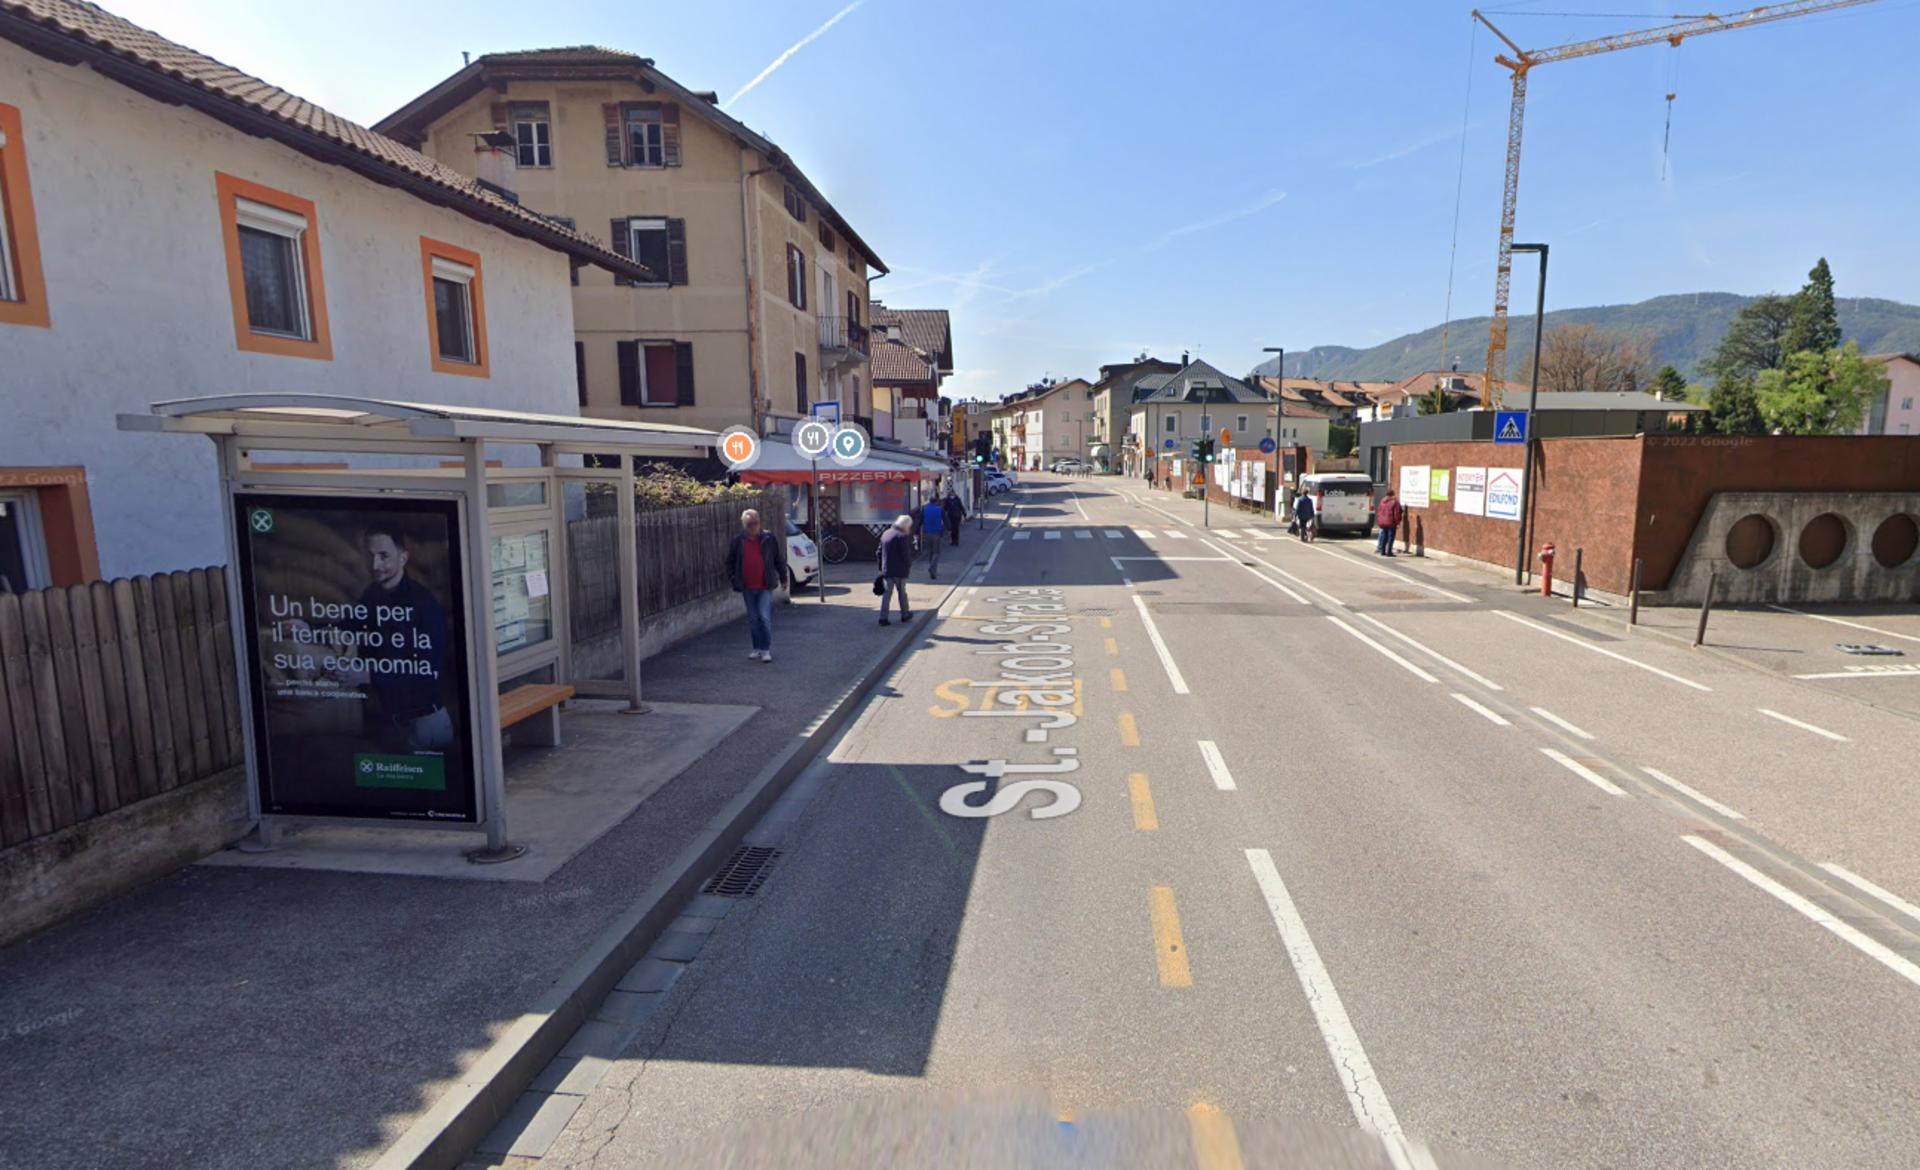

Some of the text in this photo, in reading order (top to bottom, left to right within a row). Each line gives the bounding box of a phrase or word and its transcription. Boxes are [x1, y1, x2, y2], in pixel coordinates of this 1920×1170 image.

[819, 471, 905, 482] PIZZERIA
[270, 594, 413, 627] Un bene per
[272, 621, 432, 650] il territorio e la
[274, 653, 439, 680] sua economia,
